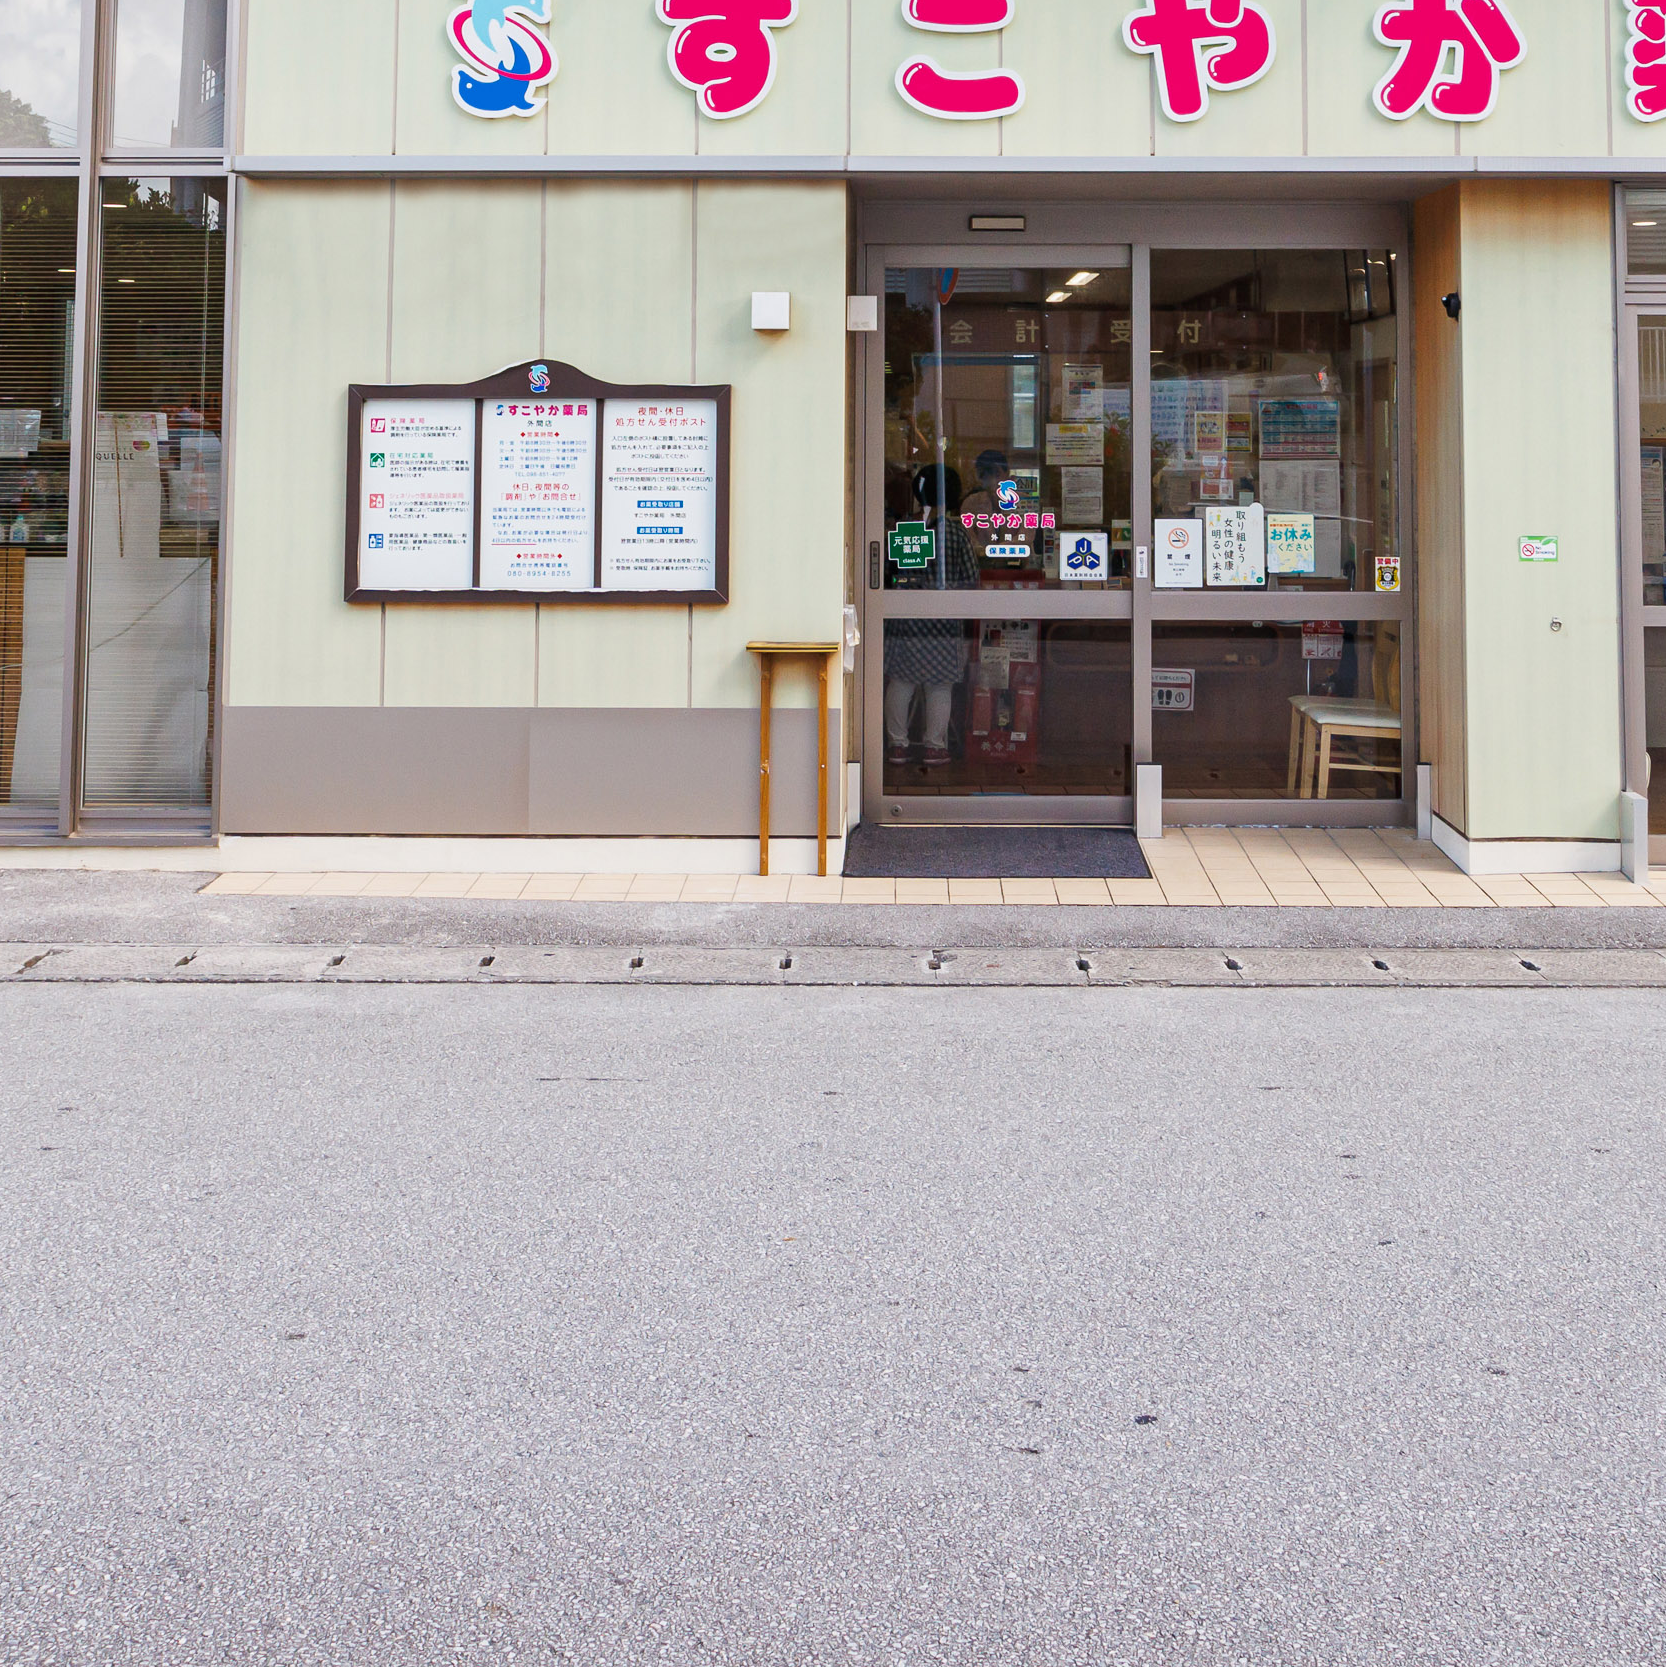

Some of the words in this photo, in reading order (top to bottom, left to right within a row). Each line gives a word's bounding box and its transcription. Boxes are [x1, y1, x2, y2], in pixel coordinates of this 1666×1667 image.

[950, 319, 1039, 344] 会計
[508, 404, 588, 416] すこやか薬局
[638, 407, 683, 415] 夜間・休日
[616, 418, 706, 426] 処方せん受付ポスト
[961, 513, 1056, 528] すこやか薬局
[893, 535, 929, 546] 元気応援
[990, 533, 1026, 541] 外間店
[1236, 511, 1246, 563] 取り組もう
[1270, 528, 1312, 542] お休み
[903, 545, 921, 553] 薬局
[1224, 518, 1234, 571] 女性の健康
[1278, 543, 1312, 551] ください
[989, 547, 1026, 555] 保険薬局
[1212, 529, 1222, 582] 明るい未来
